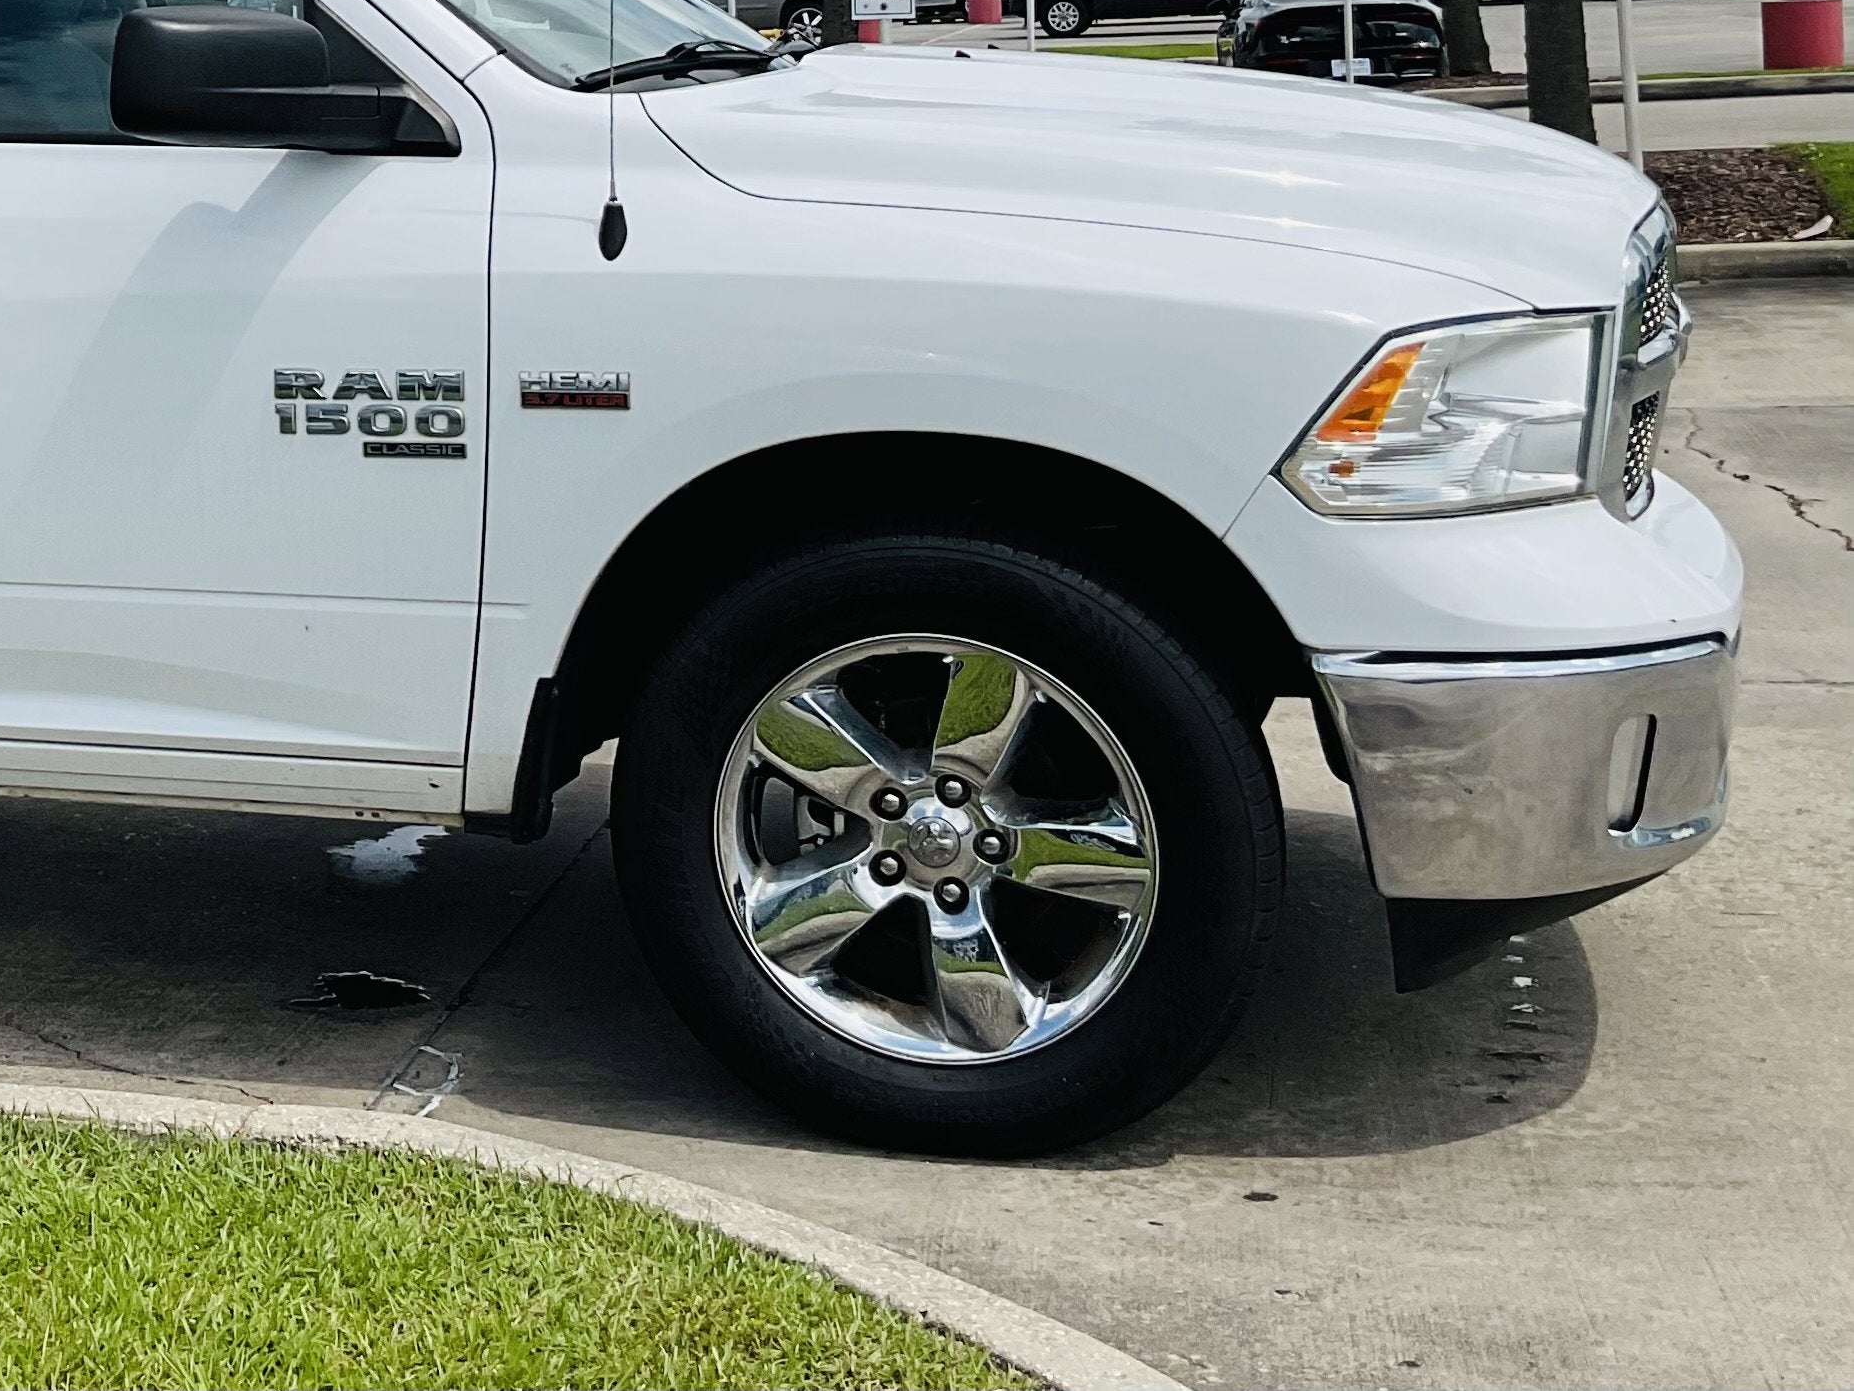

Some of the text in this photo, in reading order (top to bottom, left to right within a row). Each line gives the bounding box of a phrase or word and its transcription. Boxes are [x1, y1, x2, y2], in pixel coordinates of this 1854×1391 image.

[273, 368, 465, 401] RAM
[519, 371, 630, 391] HEMI
[523, 394, 625, 407] 5.7 LITER
[274, 403, 466, 437] 1500
[365, 443, 465, 457] CLASSIC
